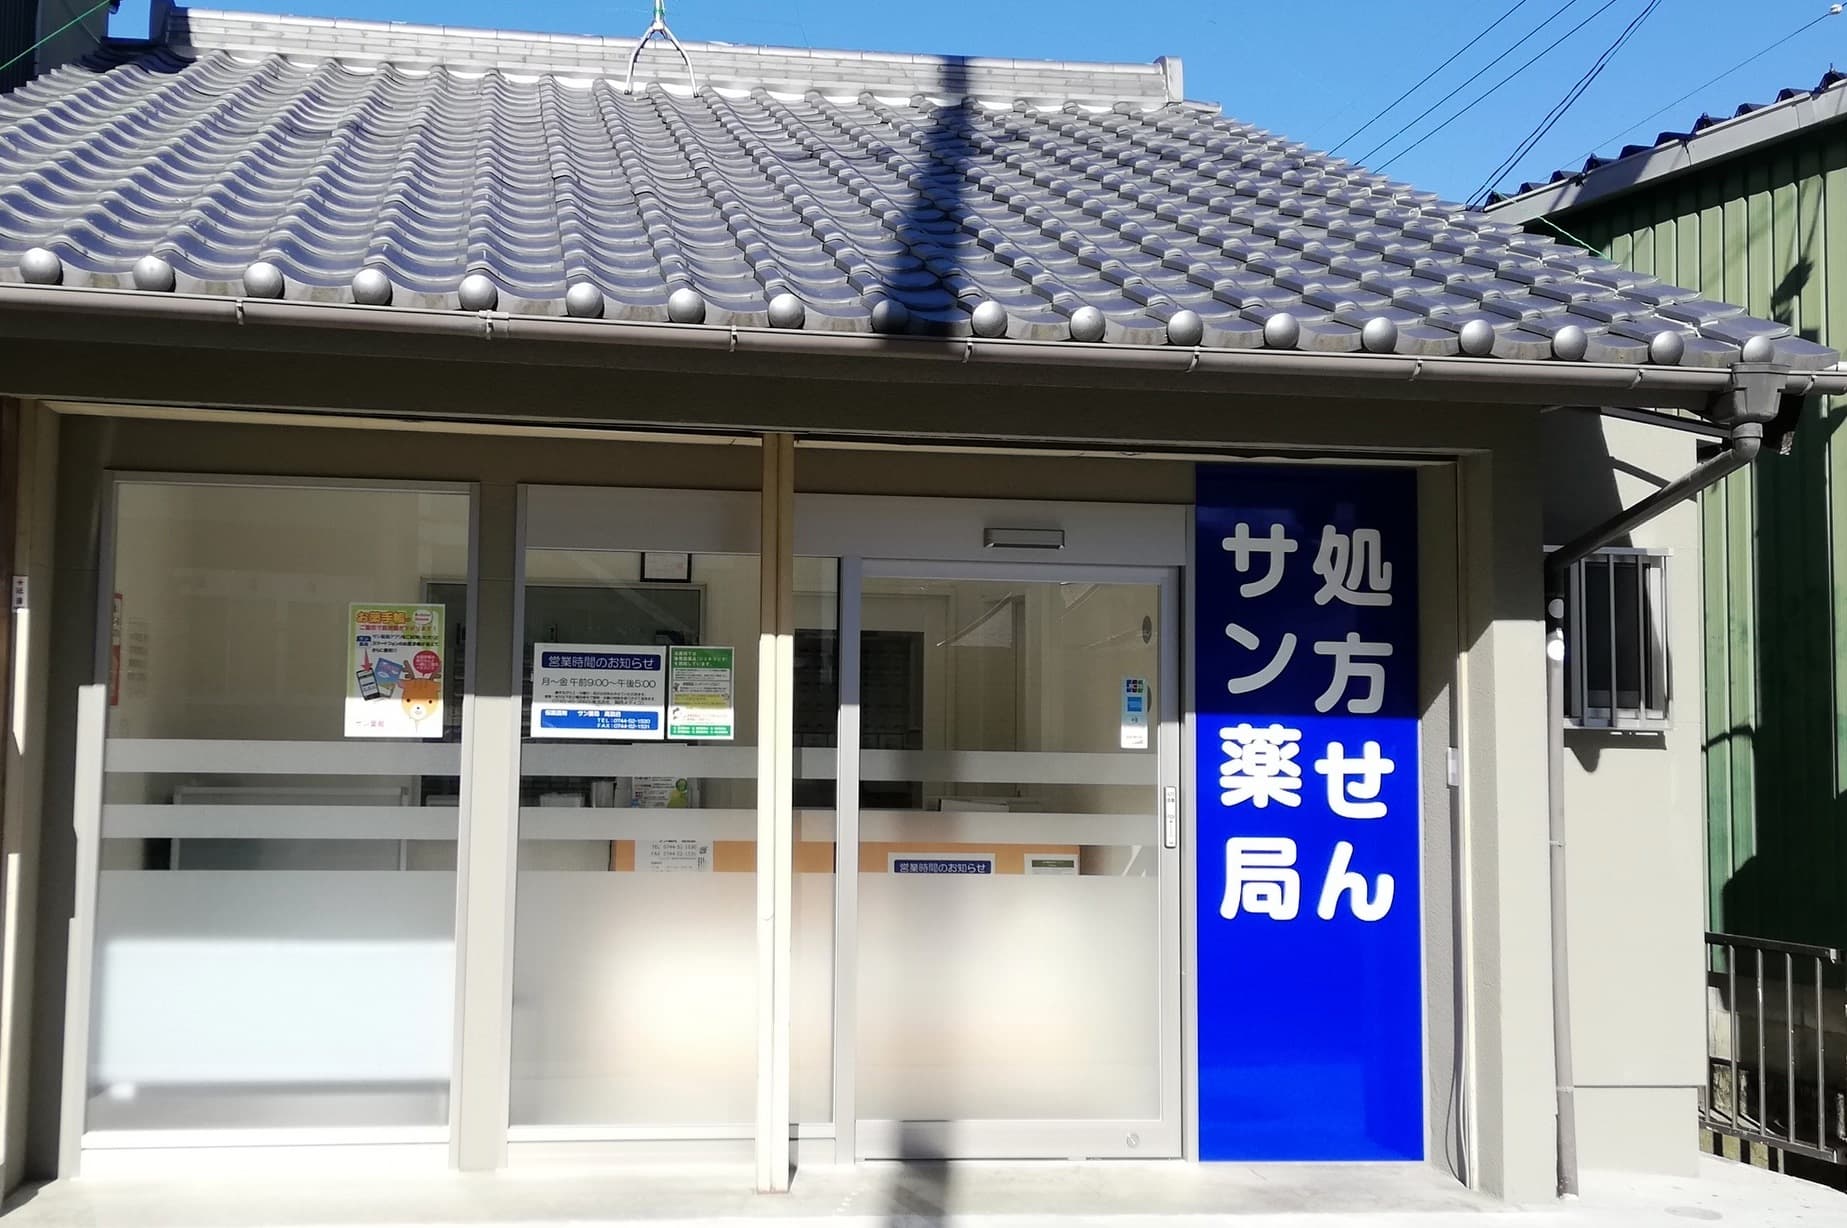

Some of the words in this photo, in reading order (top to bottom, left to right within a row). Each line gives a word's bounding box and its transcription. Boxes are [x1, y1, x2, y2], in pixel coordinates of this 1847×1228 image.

[548, 655, 654, 669] 営業時間のお知らせ
[1219, 522, 1302, 921] サン薬局
[1312, 524, 1395, 922] 処方せん
[899, 862, 986, 873] 営業時間のお知らせ
